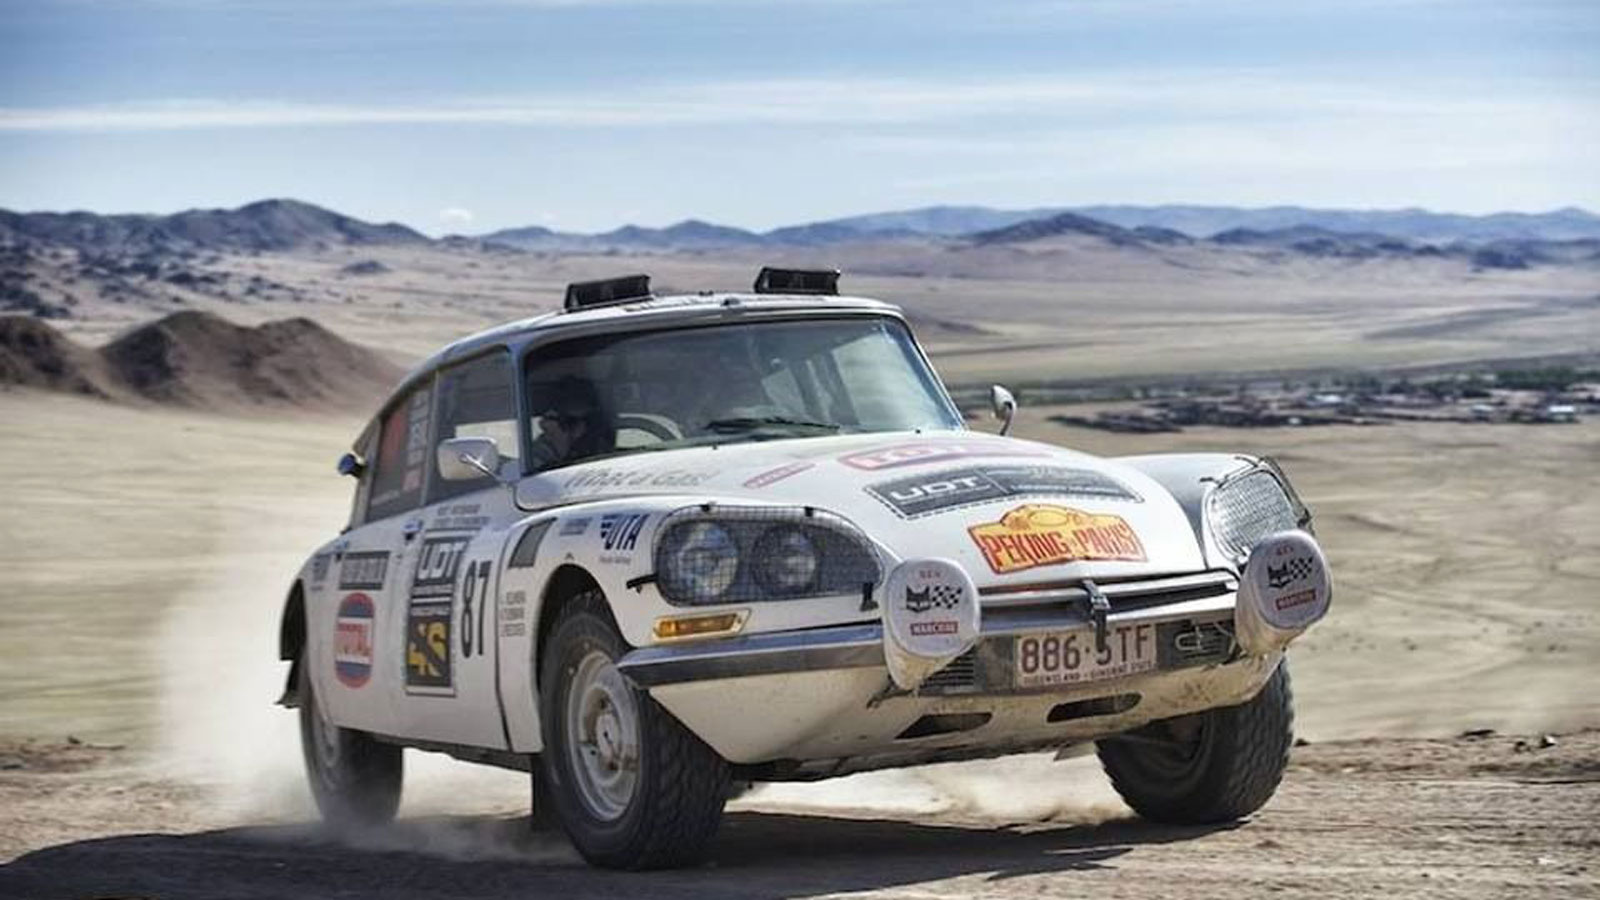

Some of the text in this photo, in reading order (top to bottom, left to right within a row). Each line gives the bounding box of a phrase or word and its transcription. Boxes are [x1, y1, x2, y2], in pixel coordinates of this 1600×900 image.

[890, 476, 978, 500] UDT
[603, 514, 650, 550] UTA
[978, 521, 1141, 568] PEKING PARIS
[418, 541, 467, 579] UDT
[461, 560, 493, 659] 87
